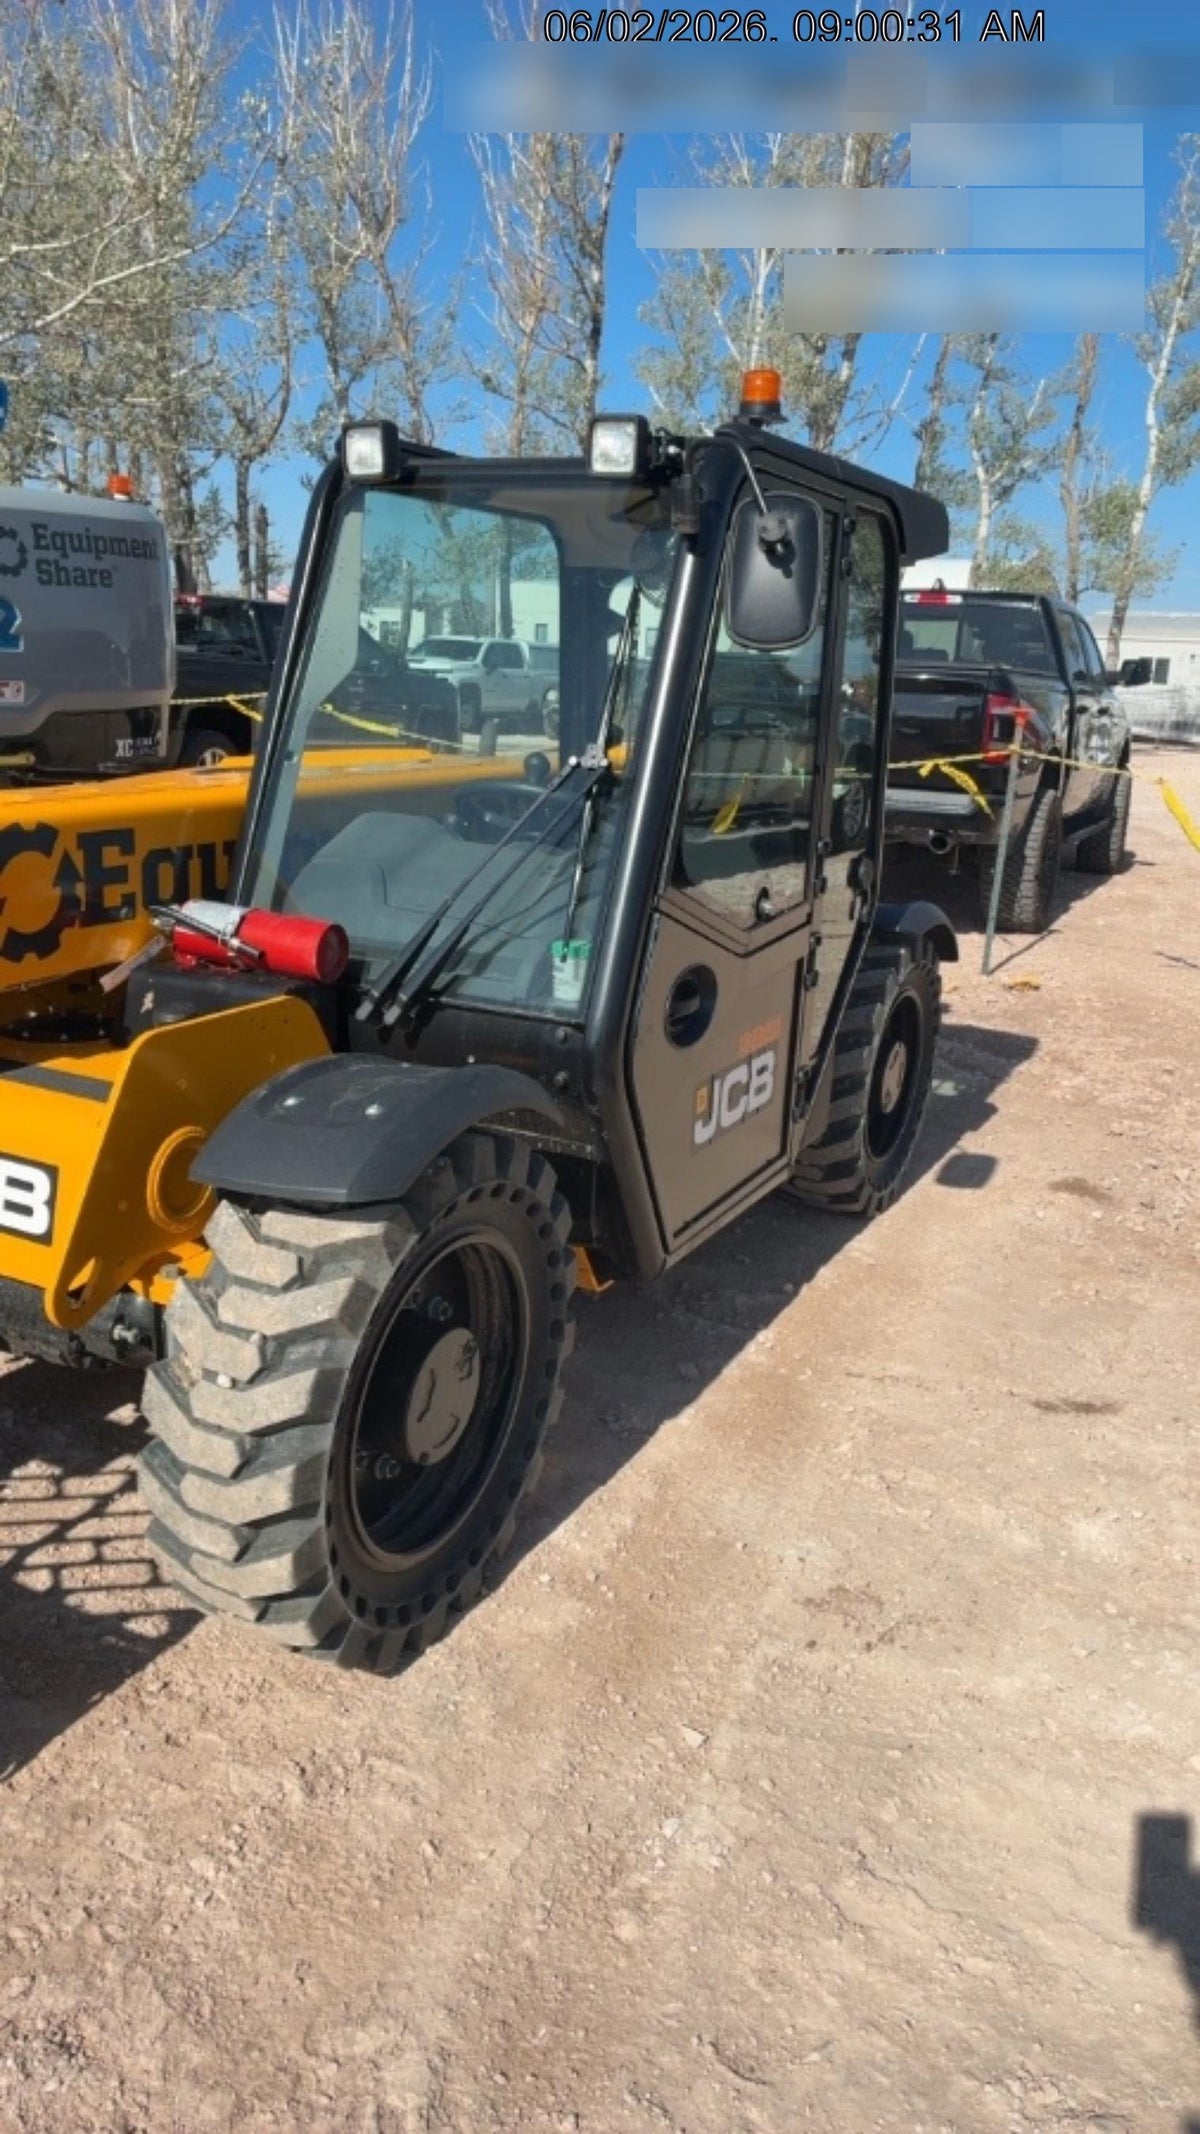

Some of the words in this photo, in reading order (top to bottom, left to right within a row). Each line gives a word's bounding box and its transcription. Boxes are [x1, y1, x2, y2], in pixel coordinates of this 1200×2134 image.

[31, 523, 160, 561] Equipment
[36, 557, 114, 589] Share
[693, 1050, 776, 1145] JCB
